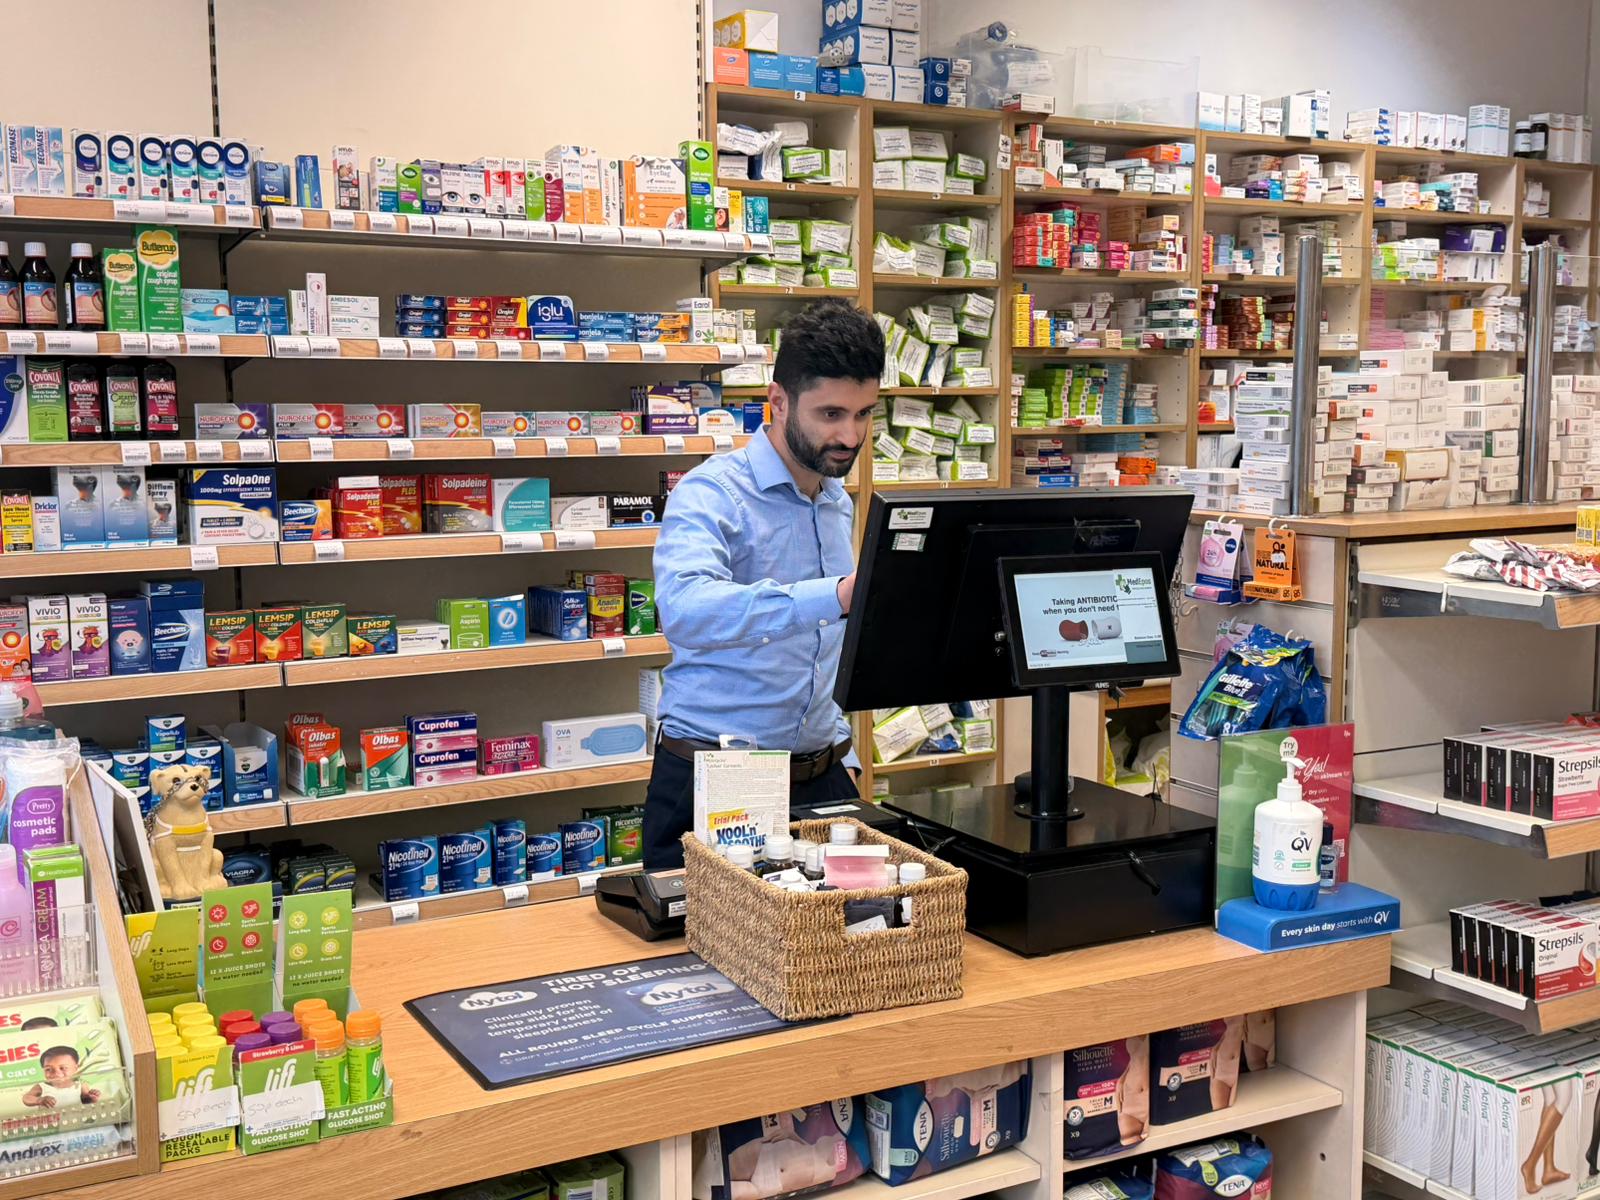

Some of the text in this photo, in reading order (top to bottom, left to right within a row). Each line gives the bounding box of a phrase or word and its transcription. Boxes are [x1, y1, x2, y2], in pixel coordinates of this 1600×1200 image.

[8, 128, 18, 164] BECONASE
[36, 129, 45, 165] BECONASE
[142, 240, 176, 253] Buttercup
[108, 261, 135, 272] Buttercup
[538, 302, 562, 320] iglu
[694, 300, 710, 310] Earol
[580, 313, 604, 322] bonjela
[635, 314, 658, 322] bonjela
[28, 370, 61, 384] COVONIA
[69, 380, 98, 394] COVONIA
[110, 380, 137, 392] COVONIA
[146, 380, 176, 393] COVONIA
[222, 474, 270, 487] SolpaOne
[379, 478, 417, 488] Solpadeine
[442, 478, 487, 490] Solpadeine
[148, 490, 168, 498] Spray
[346, 493, 380, 501] Solpadeine
[402, 488, 416, 496] PLUS
[34, 502, 58, 510] Driclor
[614, 496, 653, 506] PARAMOL
[284, 507, 315, 516] Beechams
[1256, 558, 1290, 571] NATURAL
[1052, 595, 1118, 606] Taking ANTIBIOTIC
[35, 608, 60, 616] VIVIO
[76, 606, 101, 614] VIVIO
[306, 610, 340, 619] LEMSIP
[1042, 606, 1062, 616] when
[1064, 606, 1077, 616] you
[1098, 604, 1116, 612] need
[210, 617, 246, 626] LEMSIP
[258, 614, 294, 623] LEMSIP
[460, 618, 481, 626] Aspirin
[154, 626, 188, 636] Beechams
[357, 620, 390, 630] LEMSIP
[1218, 673, 1254, 690] Gillette
[292, 714, 320, 725] Olbas
[418, 720, 459, 732] Cuprofen
[1222, 722, 1231, 734] 8
[155, 730, 180, 738] VapoRub
[308, 732, 336, 743] Olbas
[556, 729, 571, 737] OVA
[372, 735, 400, 746] Olbas
[491, 740, 531, 752] Feminax
[1283, 740, 1295, 749] Try
[419, 754, 459, 764] Cuprofen
[1558, 756, 1600, 774] Strepsils
[119, 766, 144, 774] VapoRub
[1303, 753, 1330, 784] Yes!
[1320, 772, 1342, 780] skincare
[1558, 774, 1584, 784] Strawberry
[32, 802, 51, 813] Pretty
[13, 817, 56, 829] cosmetic
[615, 818, 643, 827] nicorette
[714, 812, 749, 825] Trial Pack
[30, 825, 56, 839] pads
[497, 832, 523, 844] Nicotinell
[564, 828, 598, 842] Nicotinell
[442, 842, 482, 857] Nicotinell
[526, 842, 560, 854] Nicotinell
[1290, 837, 1312, 854] QV
[388, 848, 428, 863] Nicotinell
[226, 869, 255, 878] VIAGRA
[38, 888, 48, 932] CREAM
[1281, 910, 1391, 938] Every skin day starts with QV
[1538, 932, 1584, 953] Strepsils
[1538, 952, 1558, 963] Original
[224, 962, 266, 973] JUICE SHOTS
[303, 968, 345, 979] JUICE SHOTS
[542, 966, 642, 988] TIRED OF
[550, 980, 598, 995] NOT
[650, 983, 718, 1002] Nytol
[467, 991, 524, 1008] Nytol
[484, 1000, 592, 1024] Clinically proven
[488, 1004, 600, 1033] sleep aids for the
[488, 1008, 613, 1038] temporary relief of
[499, 1050, 526, 1058] ALL
[528, 1038, 579, 1053] ROUND
[580, 1026, 624, 1041] SLEEP
[626, 1021, 669, 1032] CYCLE
[671, 1008, 731, 1025] SUPPORT
[512, 1016, 604, 1041] sleeplessness
[252, 1044, 304, 1058] Strawberry Lime
[1072, 1046, 1115, 1063] Silhouette
[1199, 1062, 1208, 1072] M
[1384, 1052, 1394, 1085] Activa
[7, 1067, 36, 1080] care
[1404, 1058, 1414, 1092] Activa
[1422, 1066, 1432, 1098] Activa
[1442, 1073, 1450, 1107] Activa
[1104, 1095, 1114, 1106] M
[1462, 1080, 1472, 1114] Activa
[328, 1102, 386, 1120] FAST ACTING
[983, 1100, 991, 1112] M
[1480, 1088, 1490, 1122] Activa
[1502, 1097, 1512, 1131] Activa
[328, 1112, 384, 1129] GLUCOSE SHOT
[918, 1112, 928, 1142] TENA
[252, 1128, 309, 1146] GLUCOSE SHOT
[1070, 1131, 1081, 1139] X9
[166, 1133, 230, 1153] RESEALABLE
[0, 1144, 62, 1164] Andrex
[166, 1146, 200, 1158] PACKS
[1222, 1180, 1246, 1193] TENA
